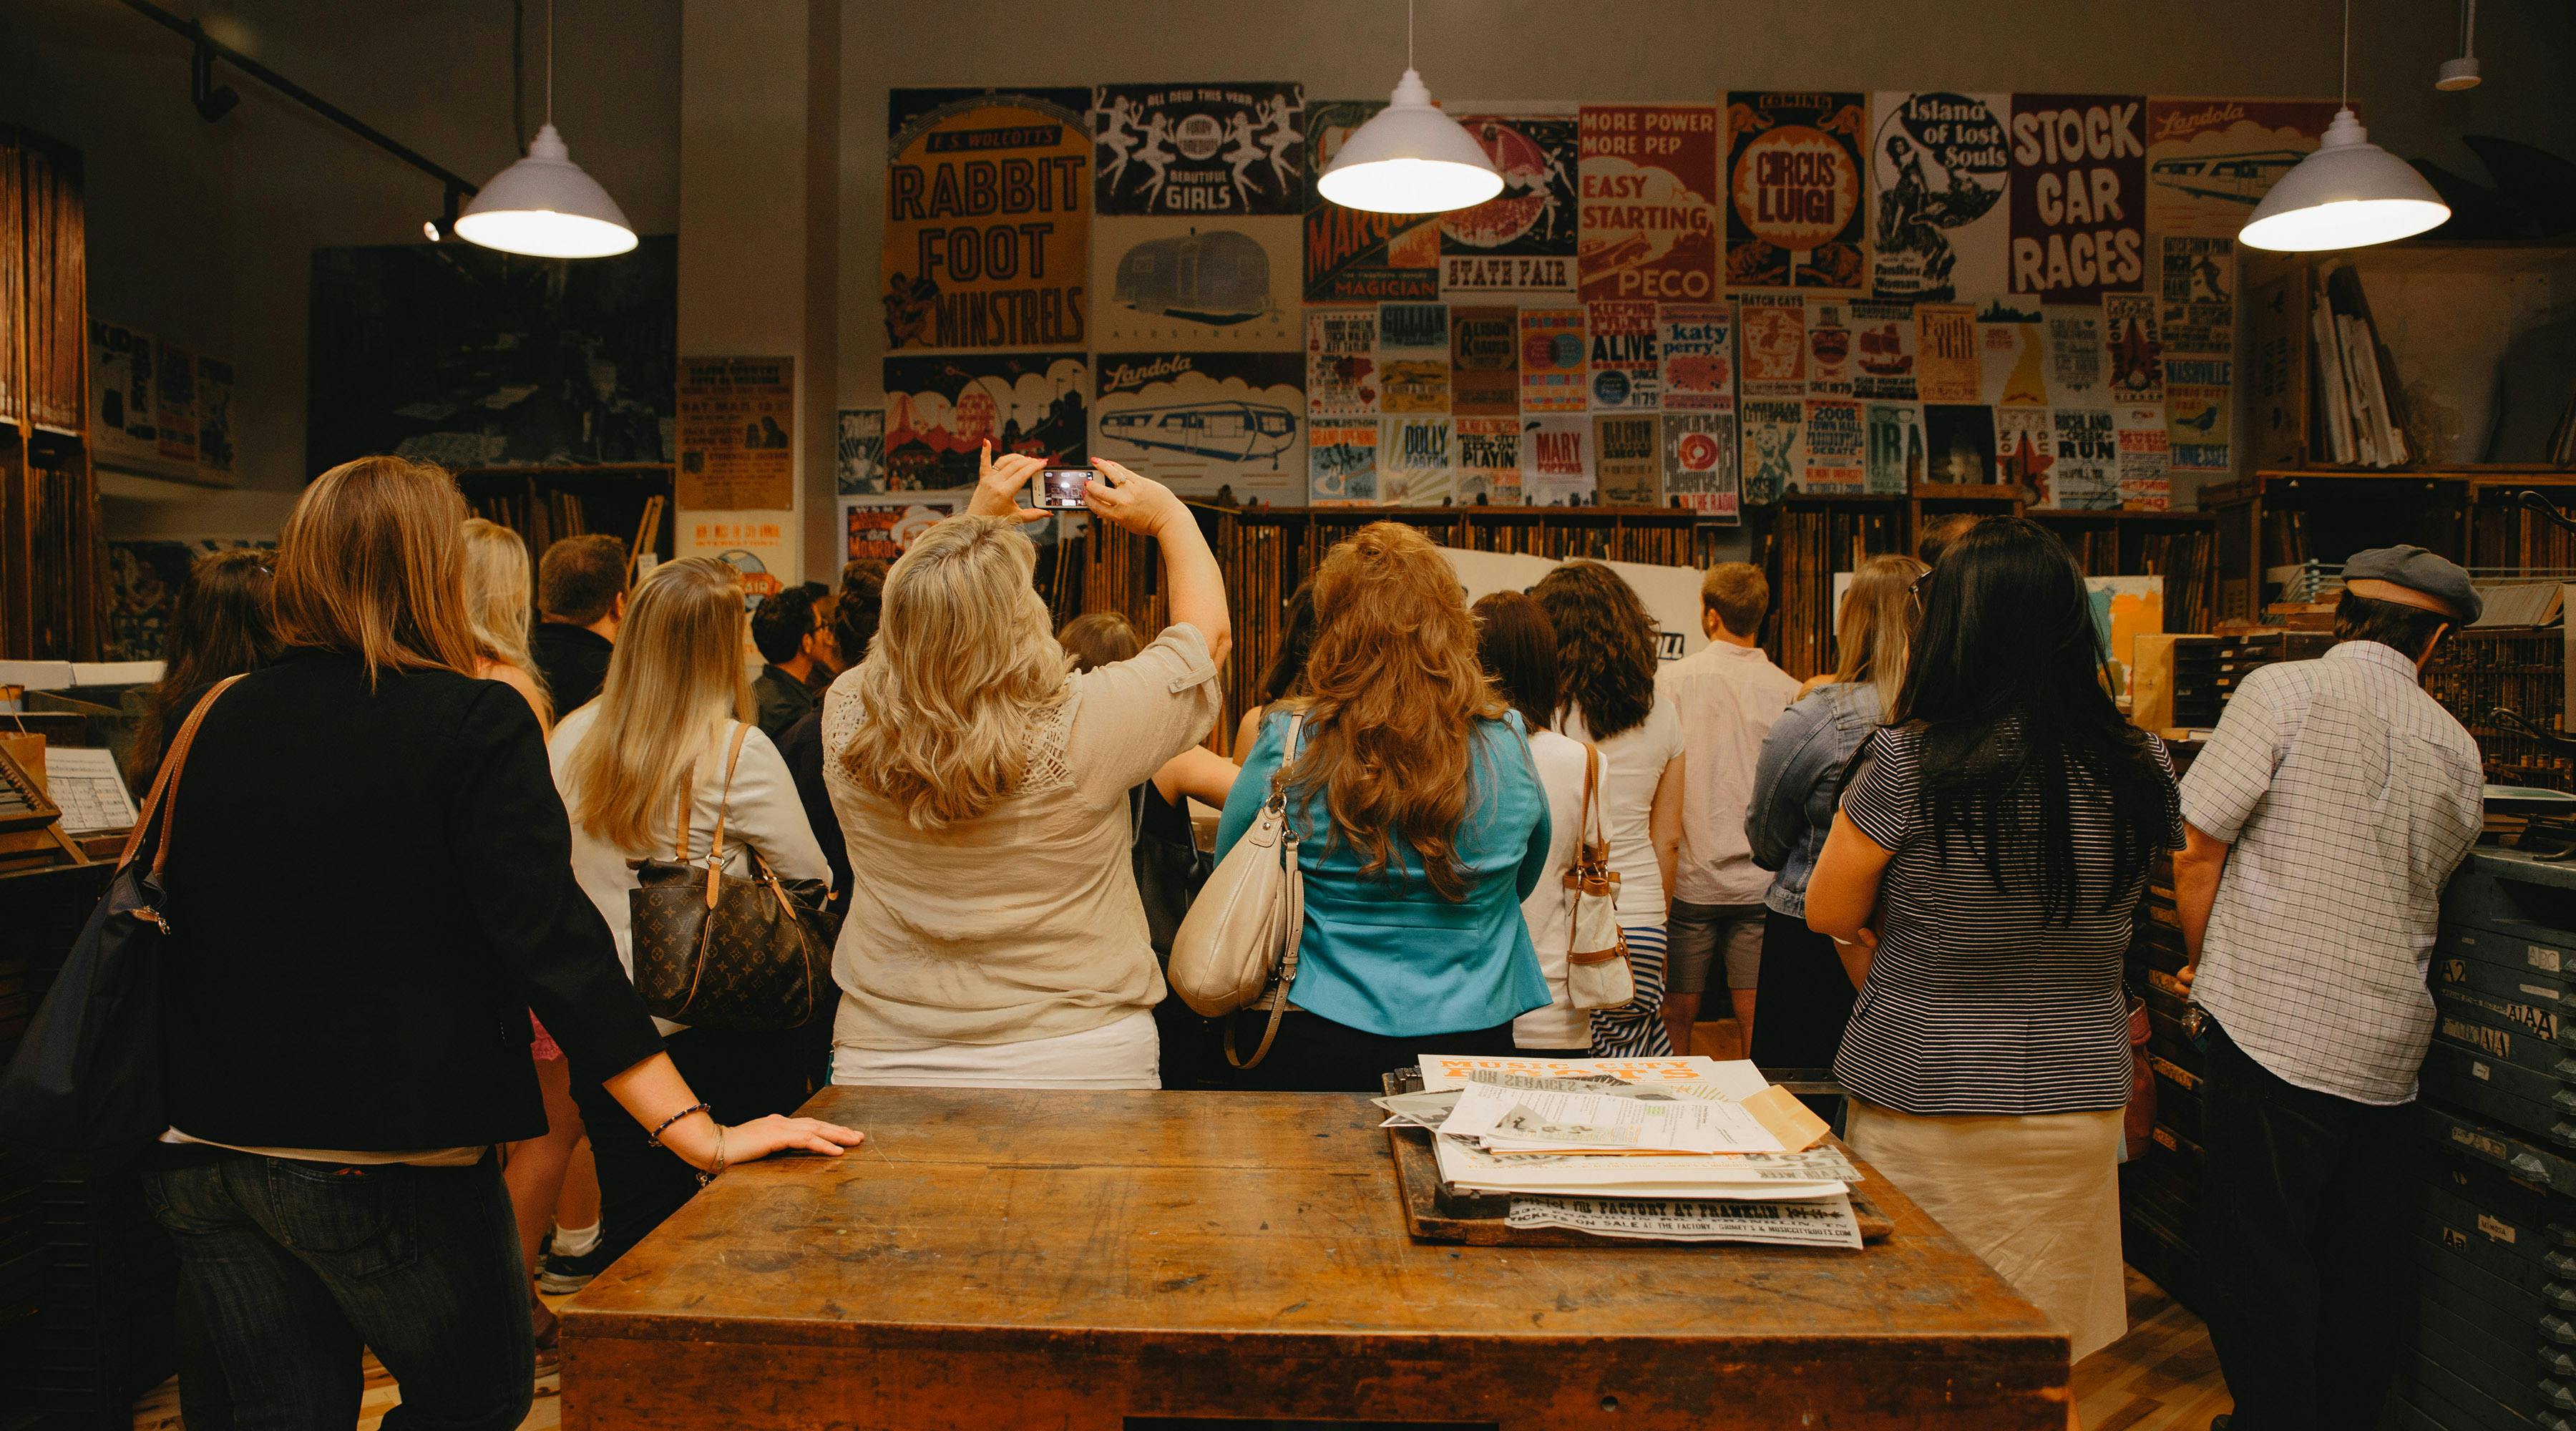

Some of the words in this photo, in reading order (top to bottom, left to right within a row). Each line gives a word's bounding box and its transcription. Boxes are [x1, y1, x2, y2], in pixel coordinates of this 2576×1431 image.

[1147, 92, 1165, 107] ALL
[1169, 90, 1194, 103] NEW
[1197, 89, 1221, 102] THIS
[1225, 90, 1252, 105] YEAR
[1582, 113, 1637, 132] MORE
[1646, 114, 1713, 132] POWER
[2155, 104, 2245, 140] Landola
[1923, 123, 1949, 144] of
[2013, 103, 2143, 167] STOCK
[1582, 136, 1636, 155] MORE
[1646, 137, 1682, 155] PEP
[1944, 146, 2007, 168] Souls
[1170, 170, 1226, 183] BEAUTIFUL
[1757, 150, 1835, 187] CIRCUS
[891, 156, 1085, 220] RABBIT
[1582, 175, 1649, 198] EASY
[2036, 167, 2124, 227] CAR
[1166, 185, 1231, 210] GIRLS
[1757, 187, 1835, 224] LUIGI
[1582, 206, 1708, 230] STARTING
[919, 223, 1054, 283] FOOT
[2013, 228, 2142, 293] RACES
[1449, 260, 1513, 287] STATE
[1518, 260, 1567, 287] FAIR
[1875, 263, 1921, 276] Panther
[1335, 280, 1435, 297] MAGICIAN
[1618, 270, 1709, 298] PECO
[1589, 303, 1655, 316] KEEPING
[1742, 294, 1775, 306] HATCH
[1777, 294, 1804, 306] CATS
[935, 287, 1085, 348] MINSTRELS
[1589, 316, 1655, 331] PRINT
[1672, 323, 1728, 343] katy
[1591, 334, 1658, 361] ALIVE
[1663, 342, 1714, 356] perry
[1104, 355, 1191, 392] Landola
[1815, 407, 1855, 420] 2008
[1807, 421, 1836, 431] TOWN
[1405, 425, 1448, 455] DOLLY
[1536, 432, 1581, 463] MARY
[1812, 446, 1856, 455] DEBATE
[1870, 423, 1924, 463] IRA
[2059, 441, 2115, 459] RUN
[1405, 455, 1448, 469] PARTON
[1537, 463, 1582, 474] POPPINS
[744, 581, 769, 593] AIR
[2441, 960, 2465, 984] A2
[1440, 1060, 1569, 1070] MUSIC
[1594, 1061, 1689, 1070] CITY
[1599, 1201, 1667, 1217] FACTORY
[1674, 1202, 1694, 1217] AT
[1699, 1203, 1780, 1219] FRANKLIN
[2444, 1229, 2465, 1250] Aa
